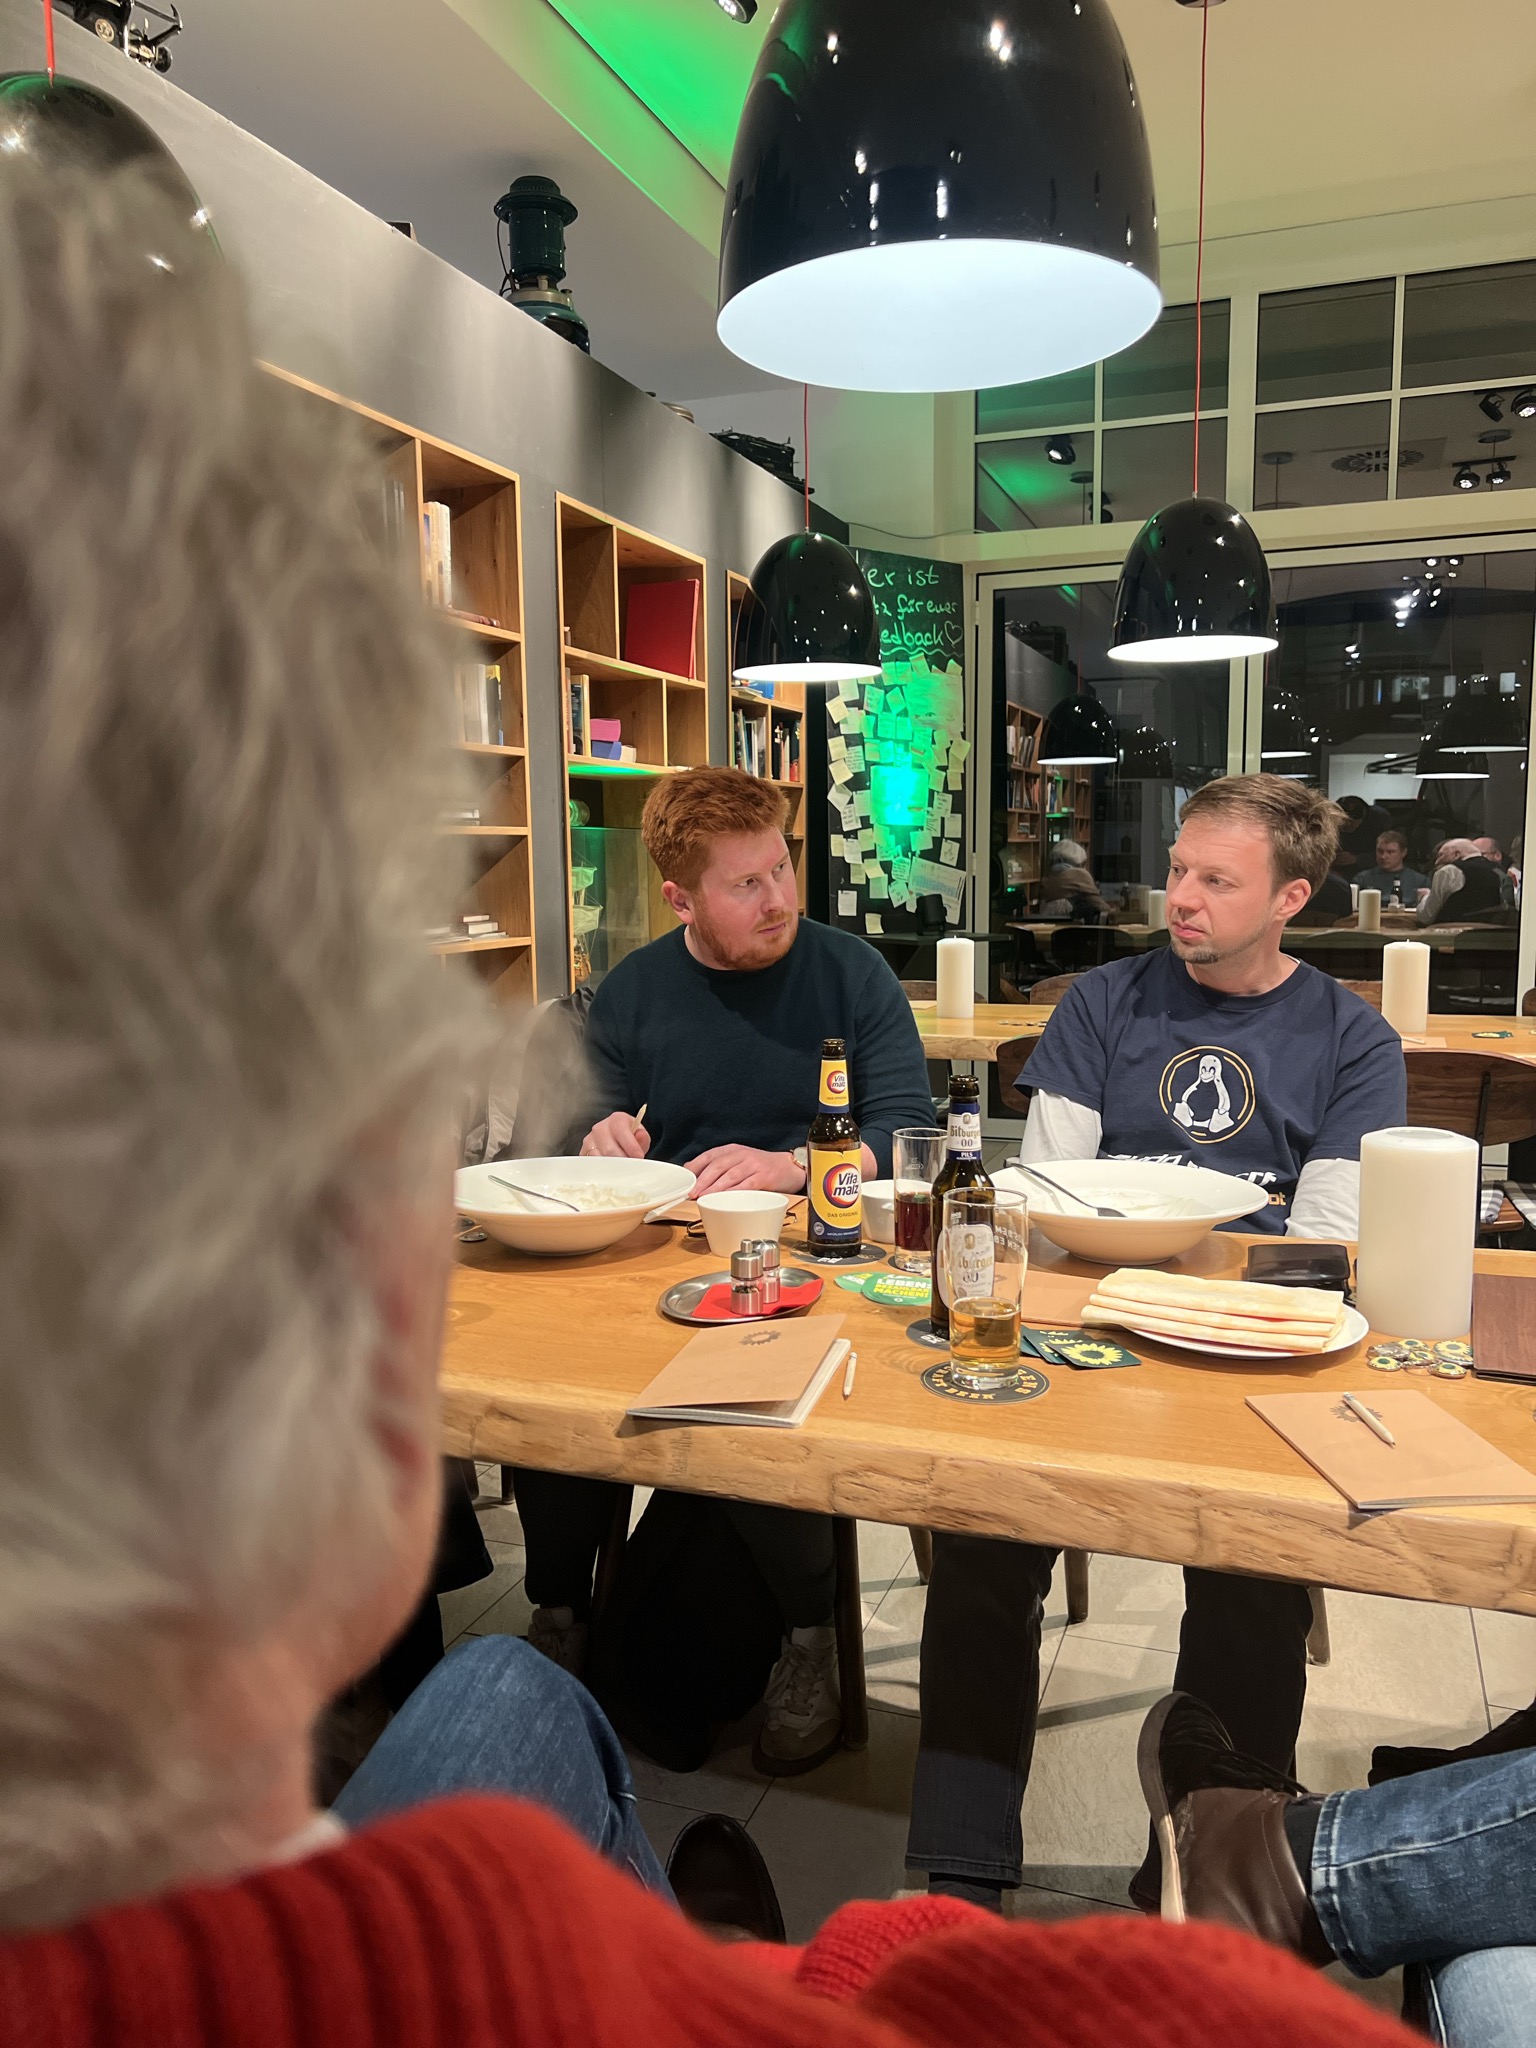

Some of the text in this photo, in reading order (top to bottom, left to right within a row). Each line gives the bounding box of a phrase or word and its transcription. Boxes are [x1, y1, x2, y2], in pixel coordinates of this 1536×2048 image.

[907, 565, 940, 587] ist
[897, 594, 924, 620] für
[926, 600, 960, 615] euer
[880, 622, 945, 647] edback
[832, 1184, 859, 1197] malz
[838, 1172, 858, 1186] Vita
[931, 1365, 996, 1400] CRAFT BEER
